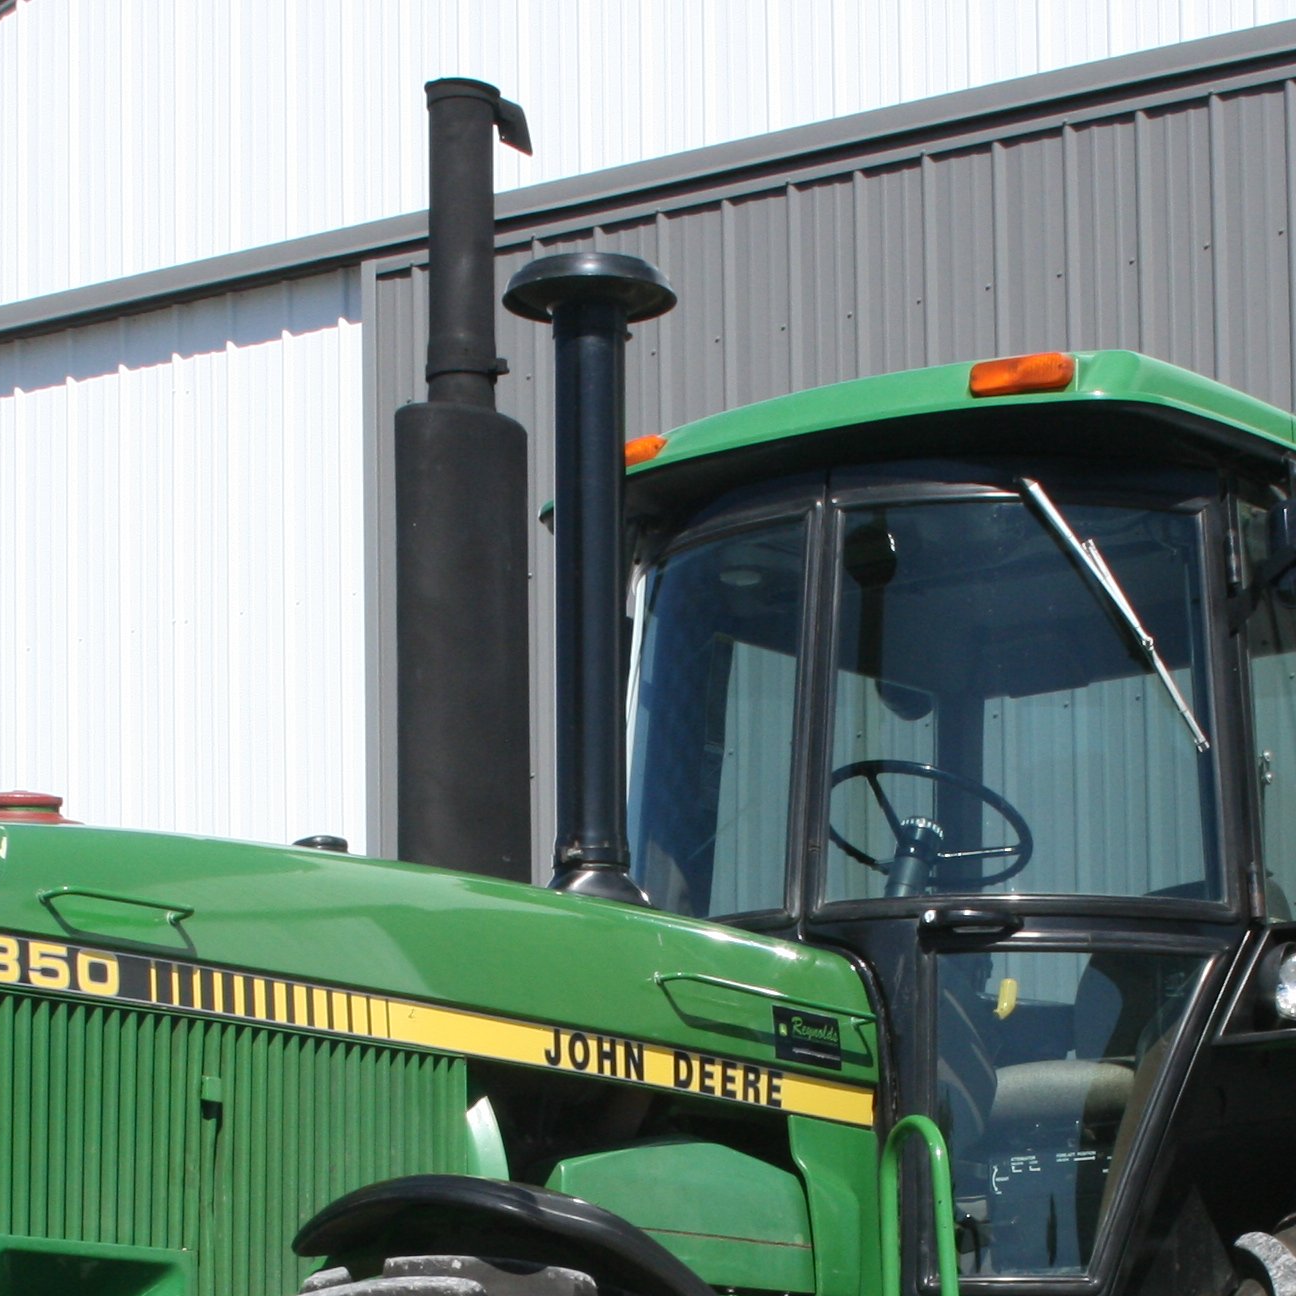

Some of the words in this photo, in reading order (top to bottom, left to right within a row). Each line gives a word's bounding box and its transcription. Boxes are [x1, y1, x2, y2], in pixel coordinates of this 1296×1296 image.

[791, 1016, 839, 1043] Reynolds
[544, 1028, 645, 1082] JOHN
[673, 1050, 783, 1108] DEERE
